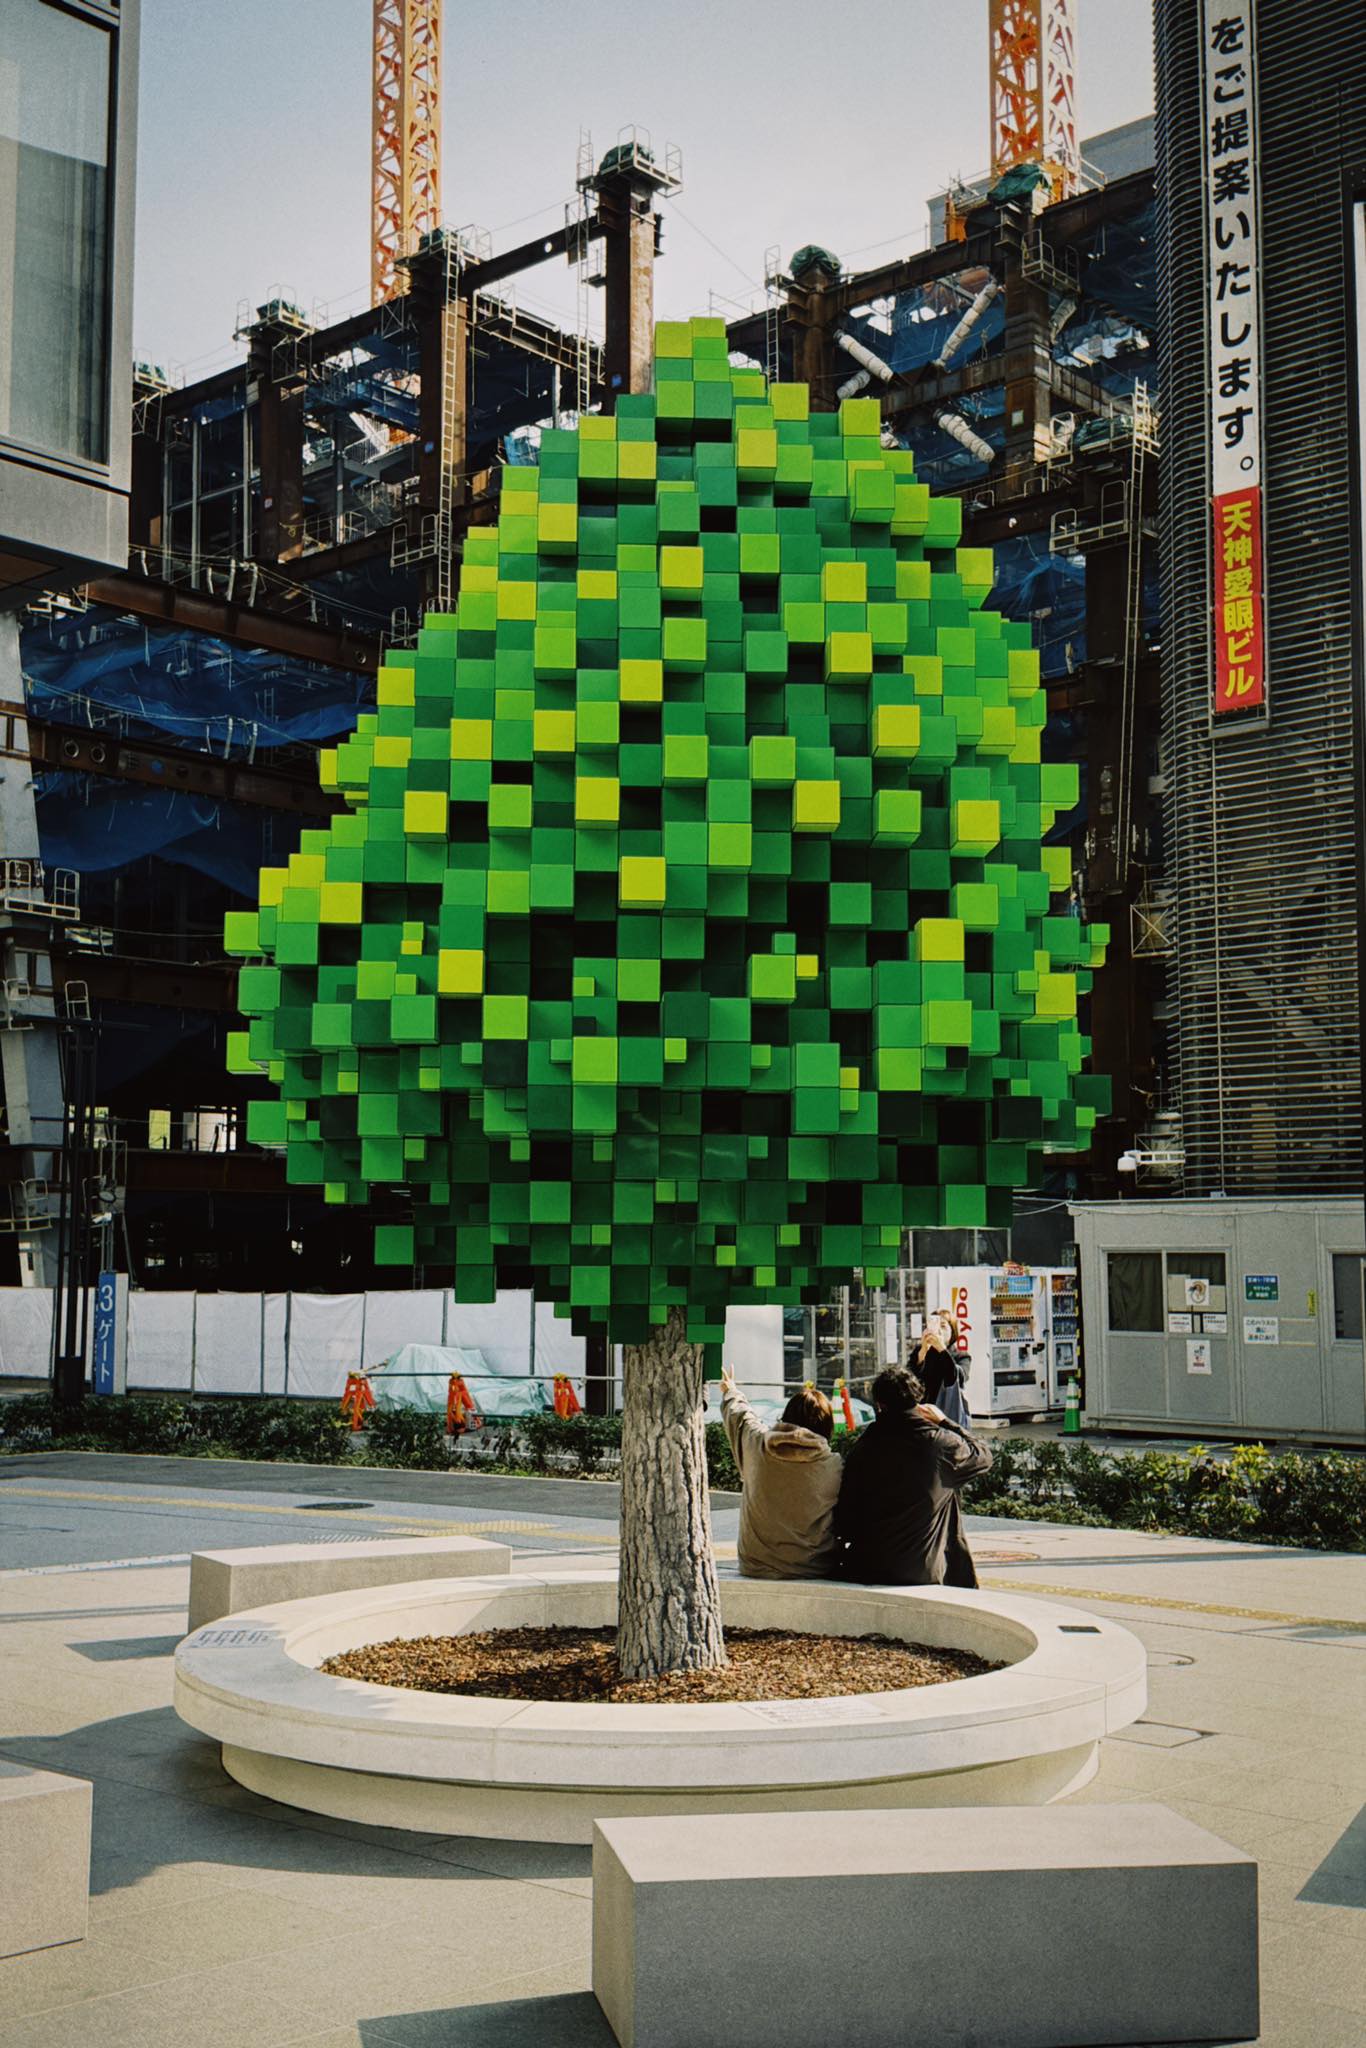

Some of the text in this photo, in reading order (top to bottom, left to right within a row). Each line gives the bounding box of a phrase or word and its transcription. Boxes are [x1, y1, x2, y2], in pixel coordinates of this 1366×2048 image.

[1211, 16, 1254, 471] をご提案いたします。
[1222, 500, 1254, 698] 天神愛眼ビル
[98, 1284, 114, 1383] 3ゲート
[956, 1287, 972, 1351] DyDo
